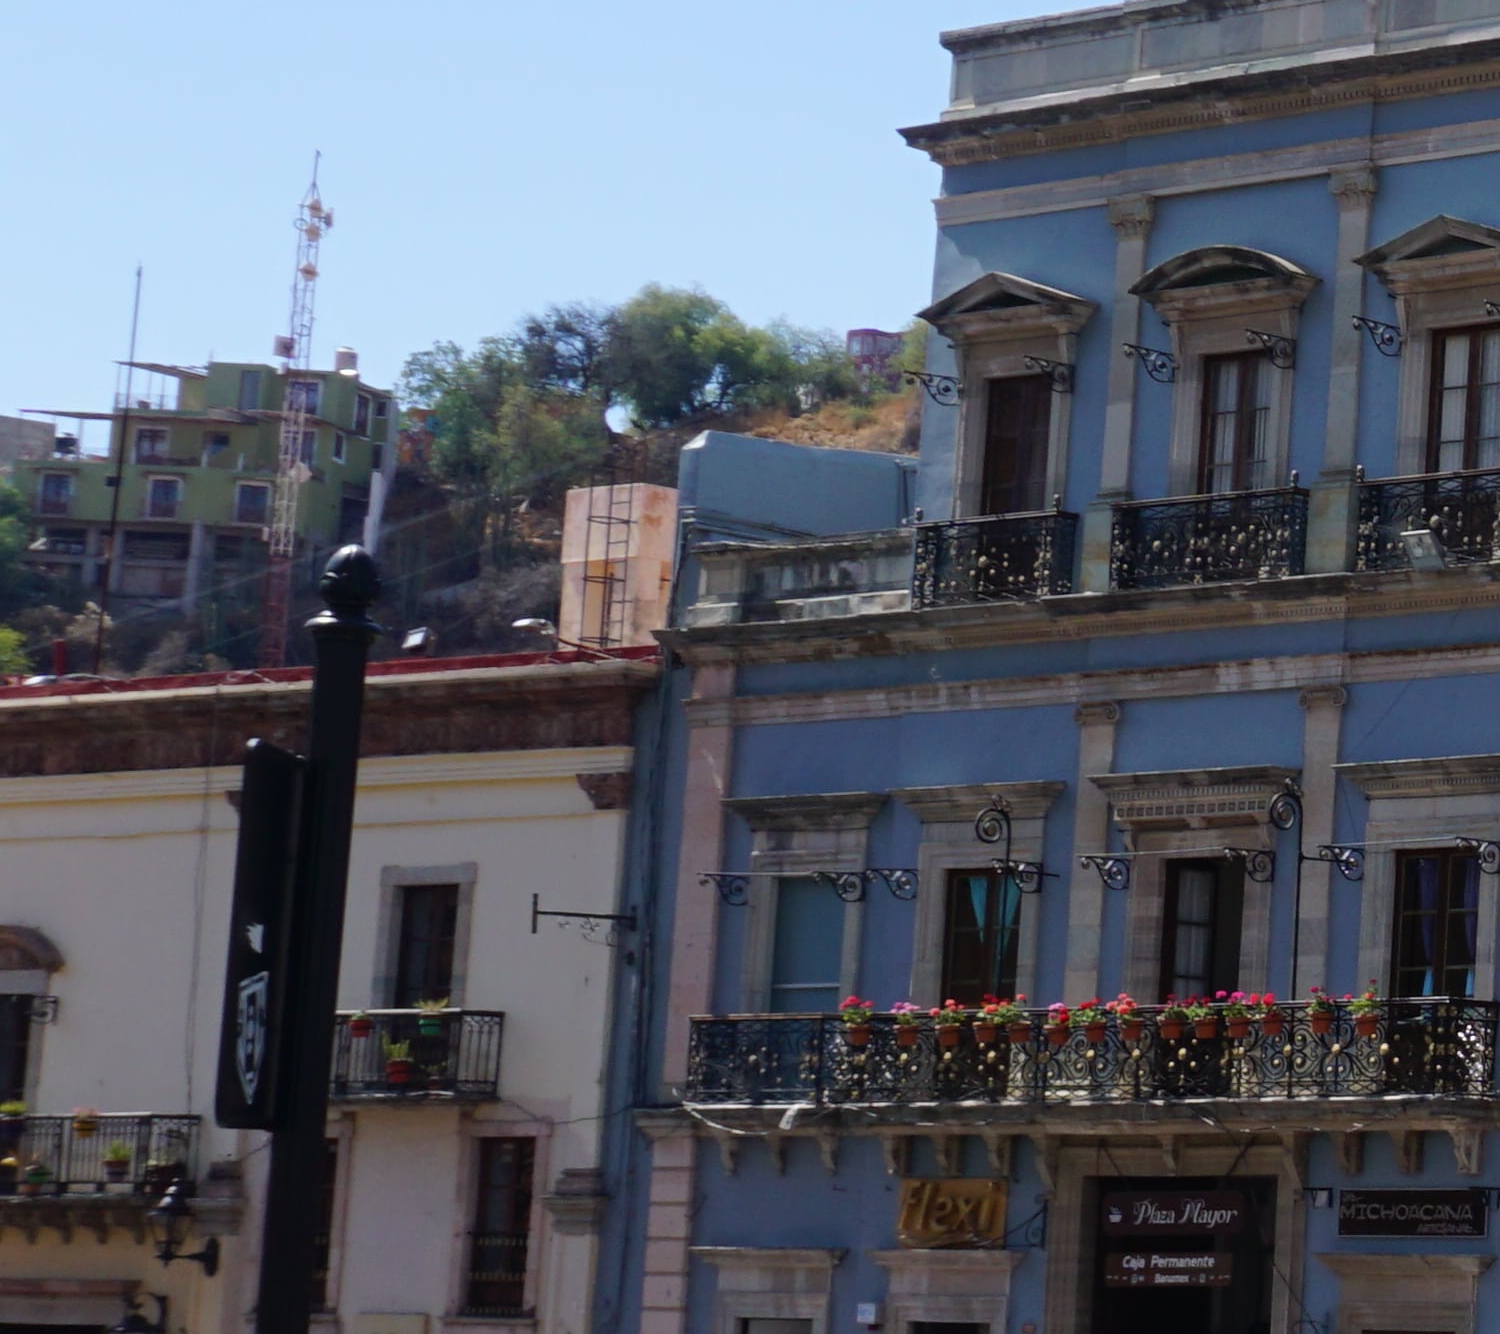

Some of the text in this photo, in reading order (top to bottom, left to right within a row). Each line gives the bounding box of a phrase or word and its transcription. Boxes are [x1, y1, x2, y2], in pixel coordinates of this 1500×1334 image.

[1133, 1198, 1238, 1229] Plaza Mayor
[1340, 1204, 1473, 1220] MICHOACANA
[1122, 1255, 1215, 1270] Caja Permanente
